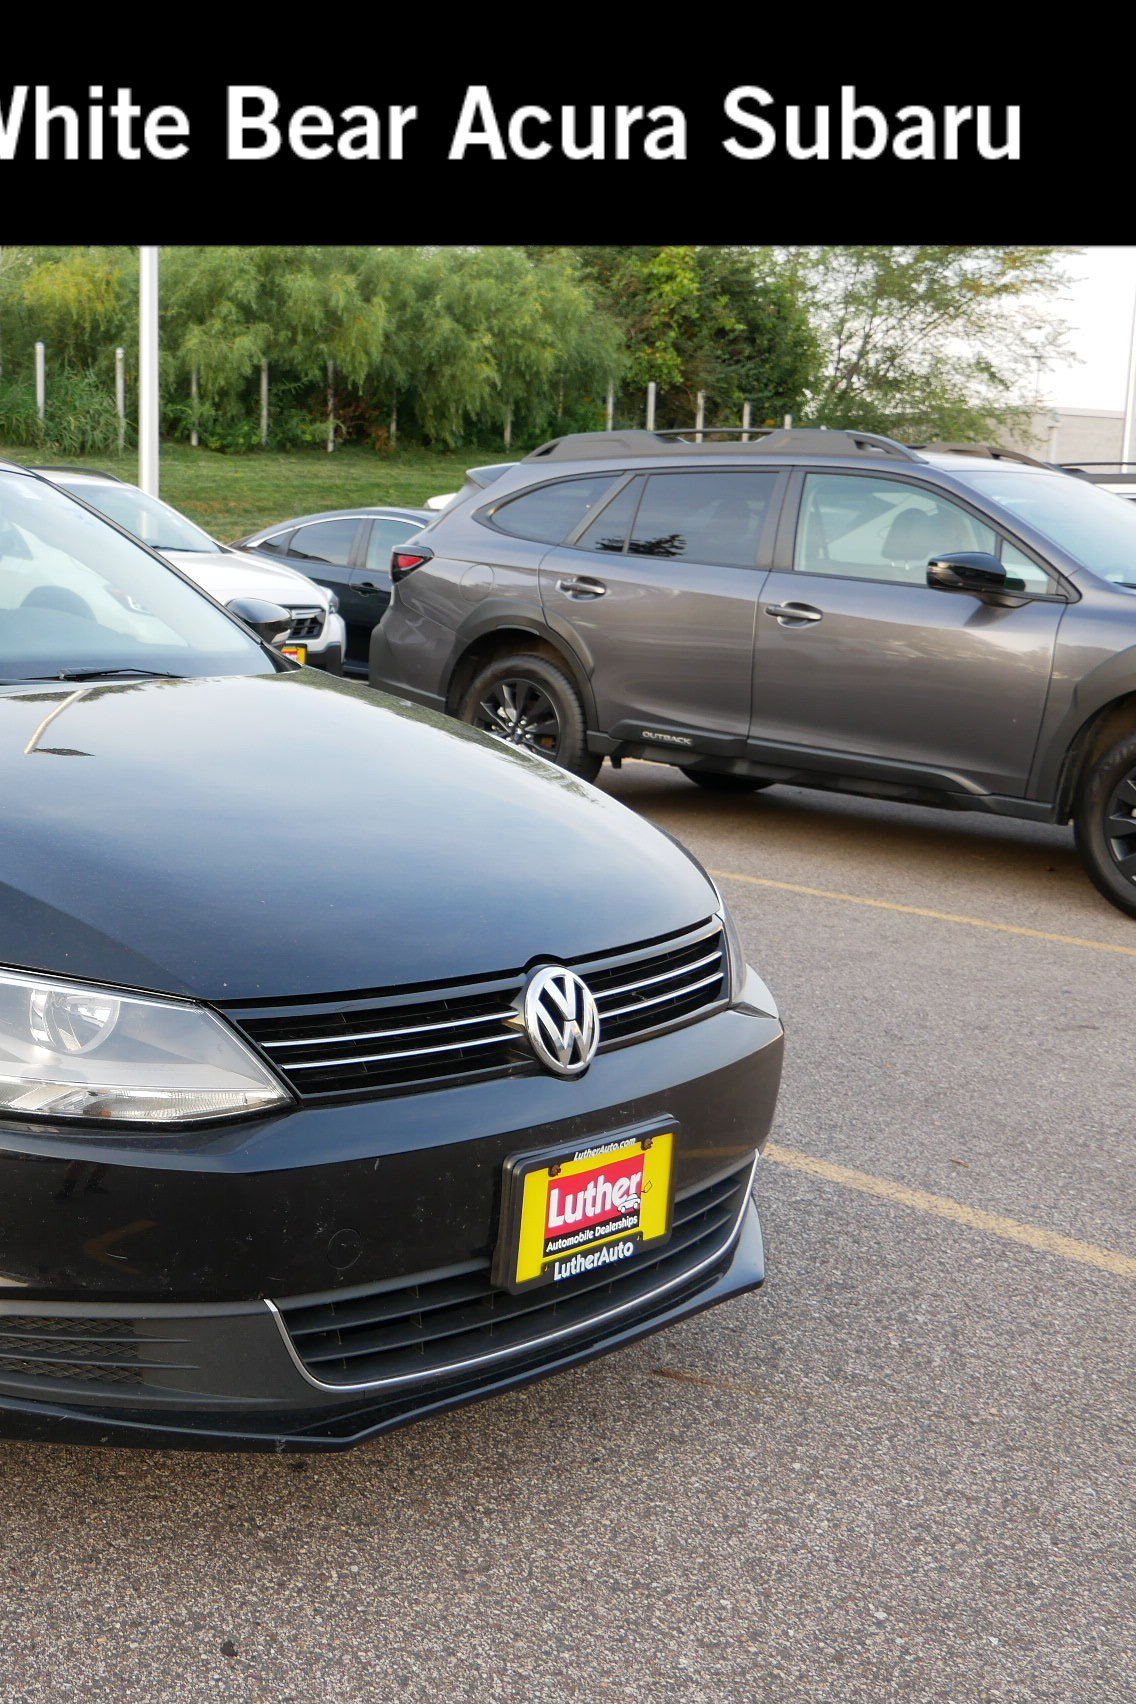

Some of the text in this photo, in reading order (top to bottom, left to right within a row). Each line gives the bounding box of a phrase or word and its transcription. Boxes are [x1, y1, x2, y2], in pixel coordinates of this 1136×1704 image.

[642, 731, 692, 745] OUTBACK
[574, 1138, 635, 1160] LutherAuto.com
[548, 1172, 641, 1228] Luther
[546, 1215, 638, 1253] Automobile Dealerships
[553, 1240, 634, 1281] LutherAuto
